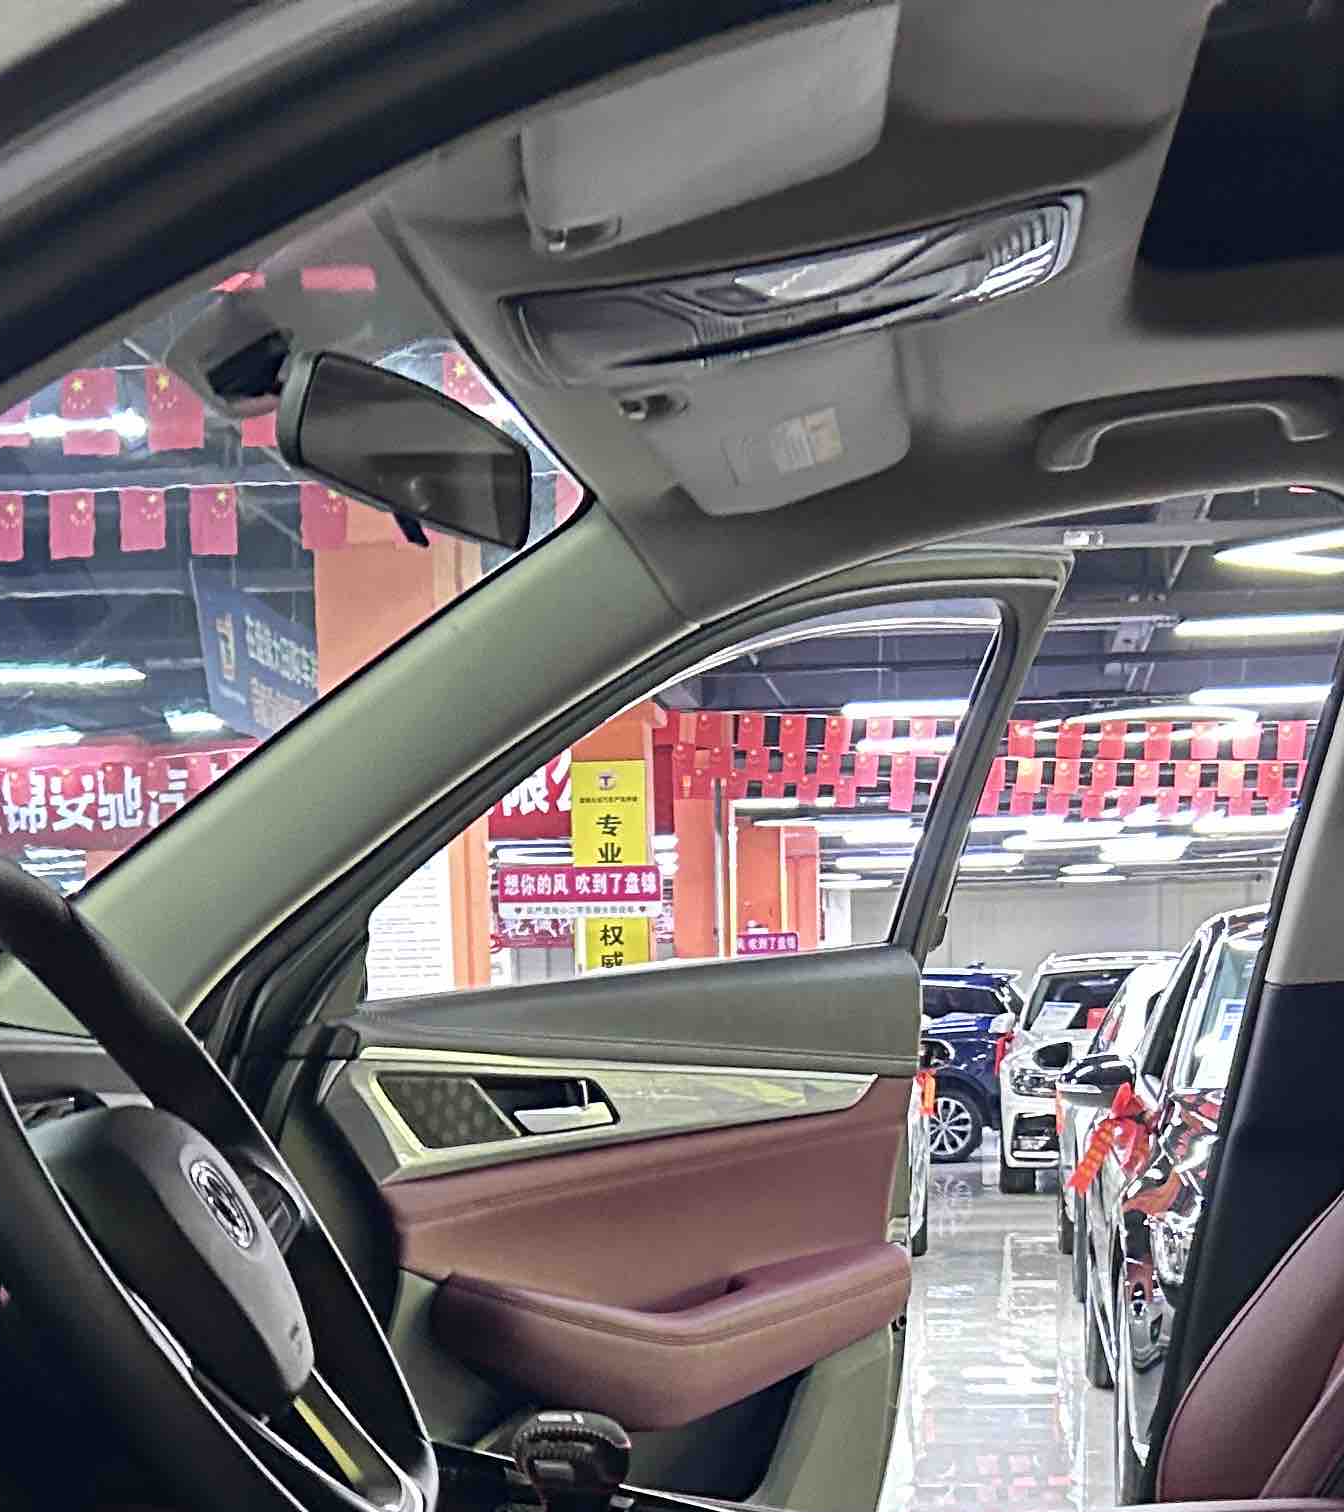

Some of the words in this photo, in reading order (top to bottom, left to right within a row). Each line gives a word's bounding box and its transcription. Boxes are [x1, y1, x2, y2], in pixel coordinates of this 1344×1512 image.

[504, 873, 568, 896] 想你的风
[575, 871, 657, 895] 吹到了盘锦
